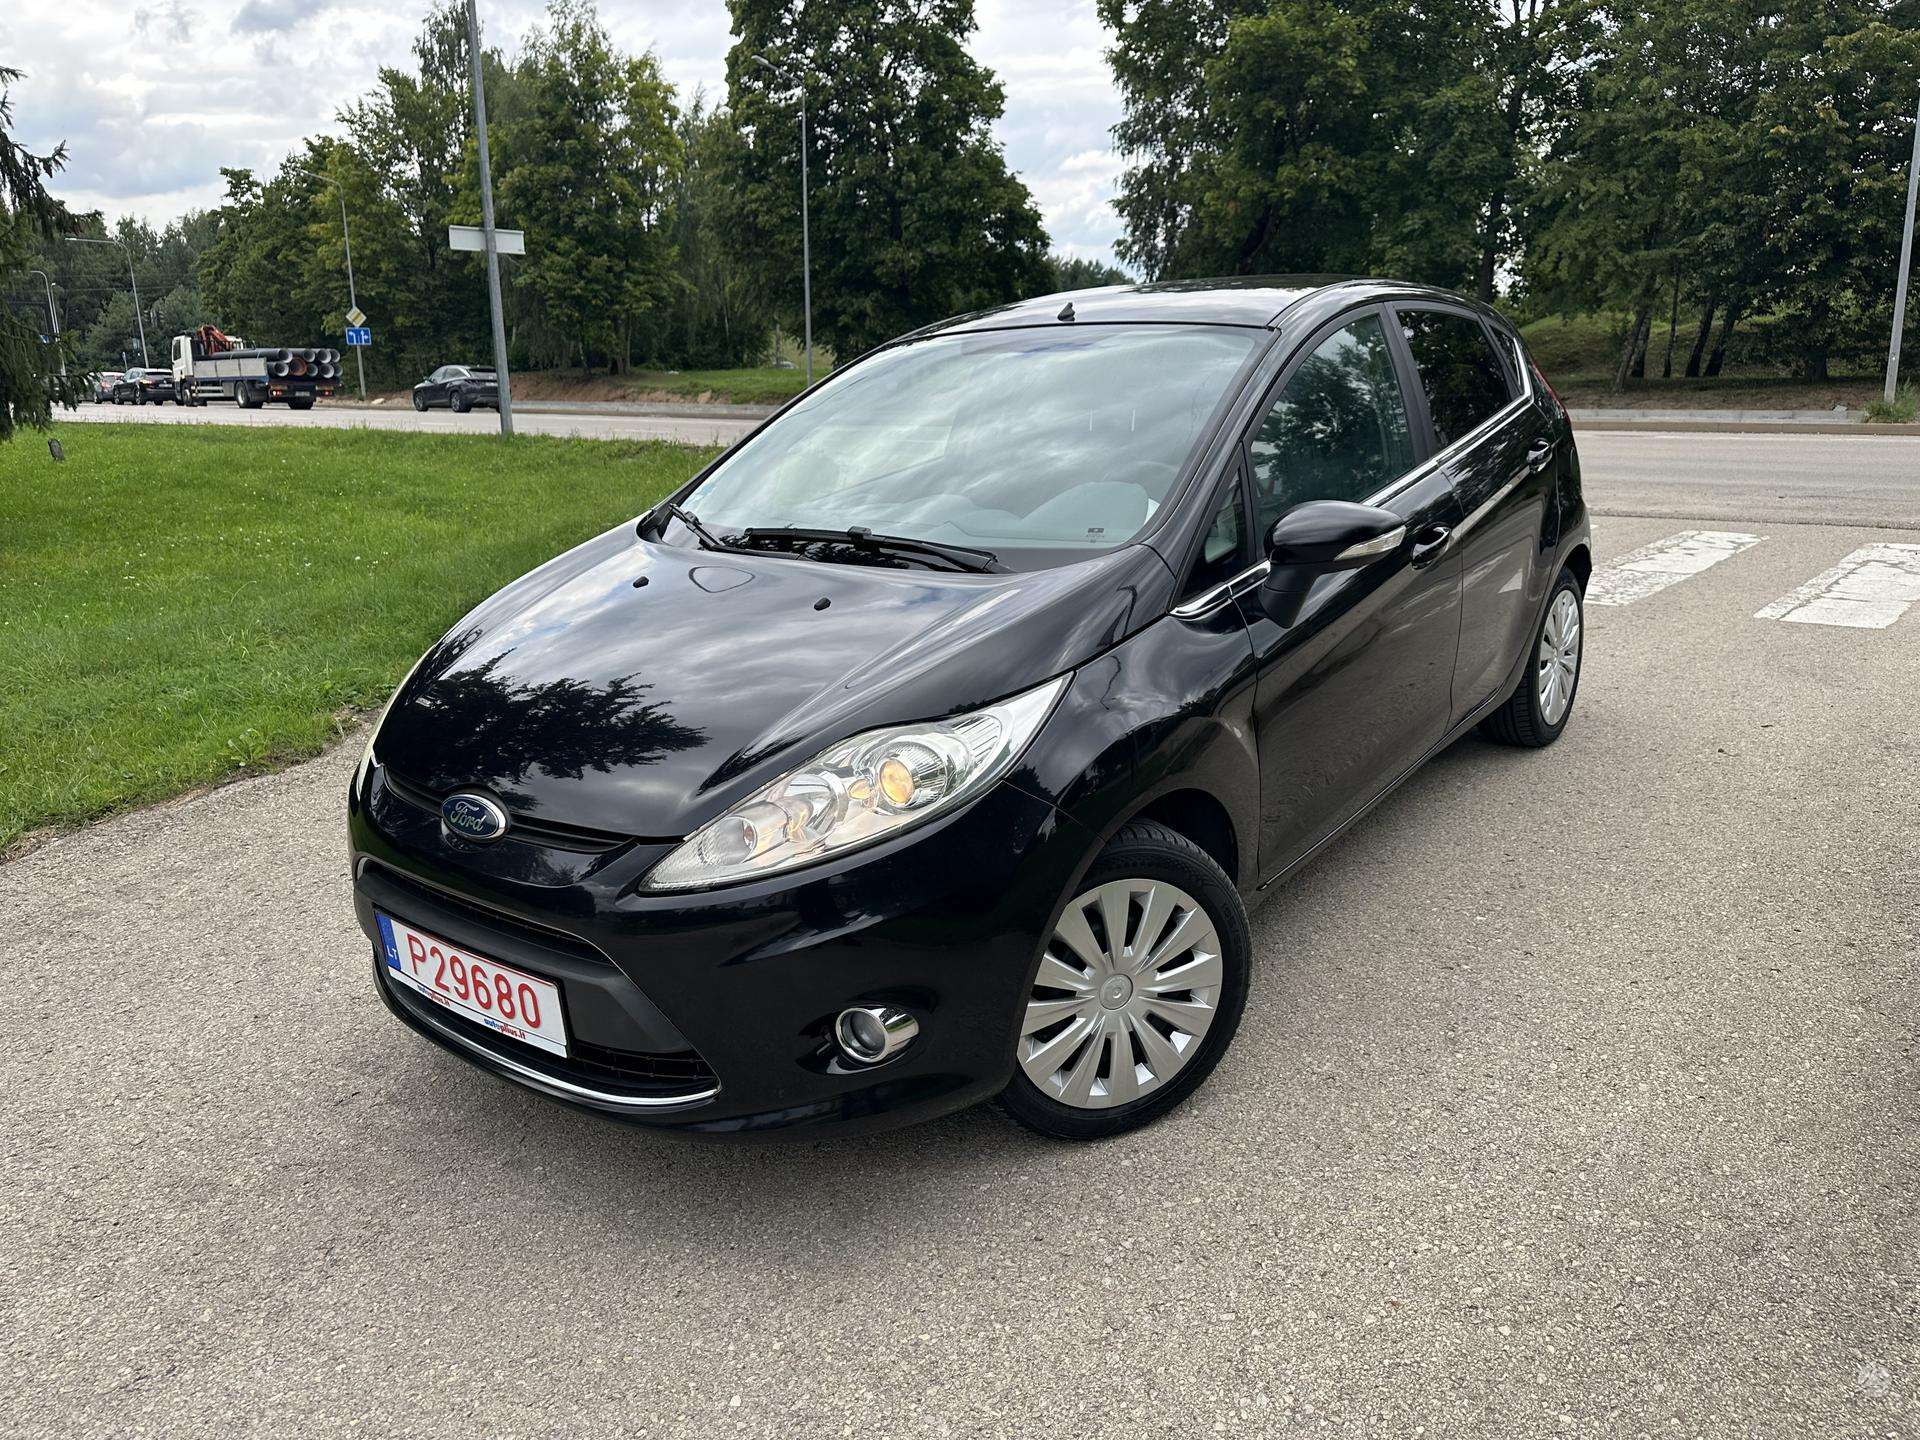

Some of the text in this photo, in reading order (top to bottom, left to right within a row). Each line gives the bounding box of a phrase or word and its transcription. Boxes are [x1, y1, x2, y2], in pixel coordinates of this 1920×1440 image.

[450, 801, 487, 831] Ford
[386, 945, 398, 960] LT
[406, 933, 541, 1029] P29680
